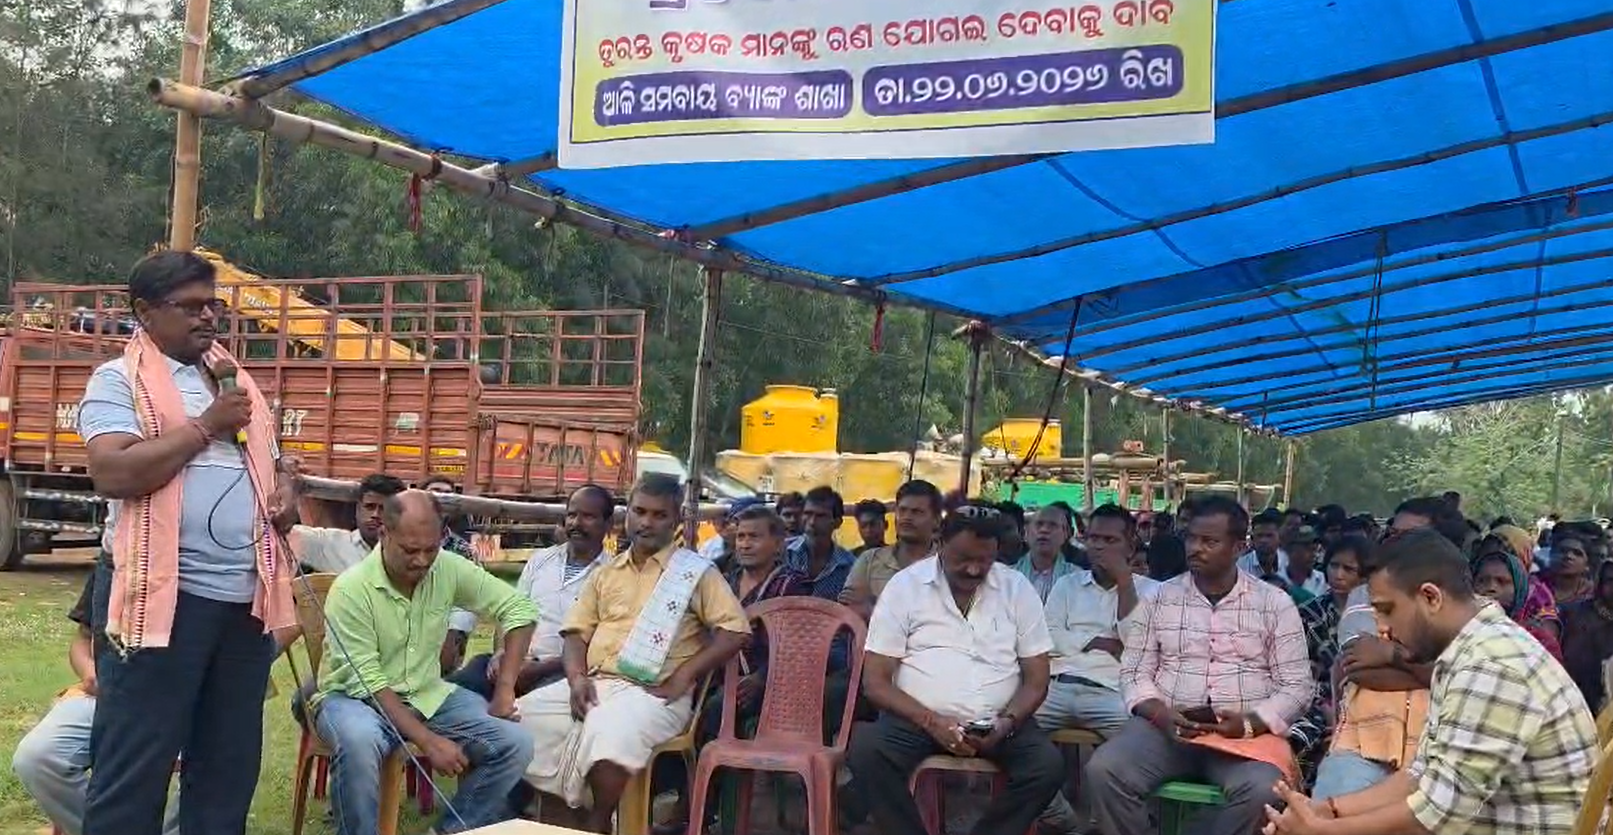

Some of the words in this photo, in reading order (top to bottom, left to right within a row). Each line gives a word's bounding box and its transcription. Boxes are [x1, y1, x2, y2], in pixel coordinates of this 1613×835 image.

[598, 33, 653, 68] ତୁରନ୍ତ
[661, 31, 732, 63] କୃଷକ
[741, 28, 819, 60] ମାନଙ୍କୁ
[998, 5, 1104, 37] ଦେବାକୁ
[602, 80, 635, 116] ଆଳି
[640, 83, 717, 112] ସମବାୟ
[725, 83, 787, 110] ବ୍ୟାଙ୍କ
[794, 83, 845, 110] ଶାଖା
[874, 63, 1109, 105] ତା.୨୨.୦୬.୨୦୨୬
[1120, 49, 1173, 90] ରିଖ
[536, 440, 586, 465] TATA
